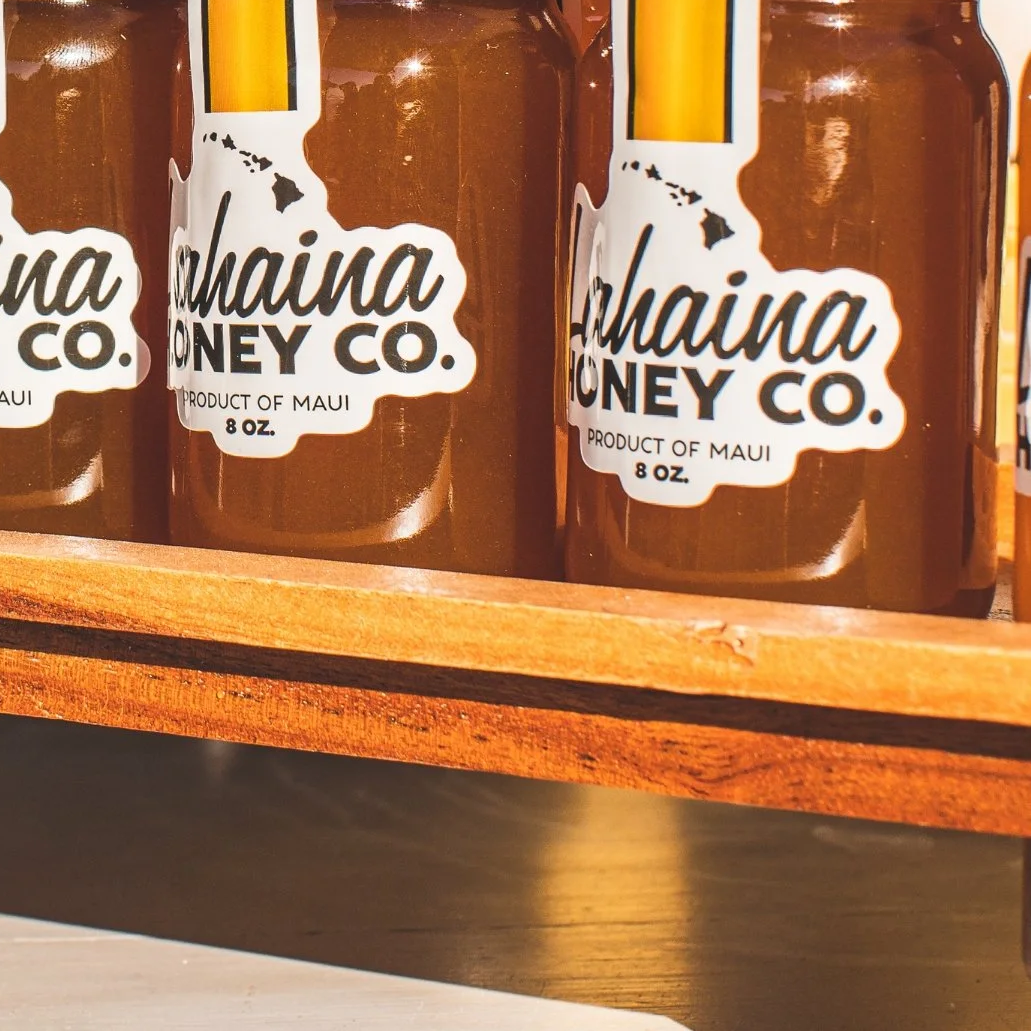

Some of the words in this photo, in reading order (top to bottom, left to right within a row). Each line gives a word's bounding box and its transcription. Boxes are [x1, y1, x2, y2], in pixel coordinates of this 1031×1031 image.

[169, 177, 444, 319] ahaina
[18, 322, 132, 371] CO.
[170, 319, 312, 376] ONEY
[334, 320, 456, 376] CO.
[183, 391, 251, 412] PRODUCT
[257, 394, 283, 412] OF
[293, 394, 349, 412] MAUI
[758, 370, 883, 426] CO.
[225, 418, 238, 435] 8
[242, 418, 275, 436] OZ.
[588, 428, 665, 456] PRODUCT
[672, 438, 701, 458] OF
[710, 443, 770, 463] MAUI
[635, 462, 647, 479] 8
[653, 465, 690, 484] OZ.
